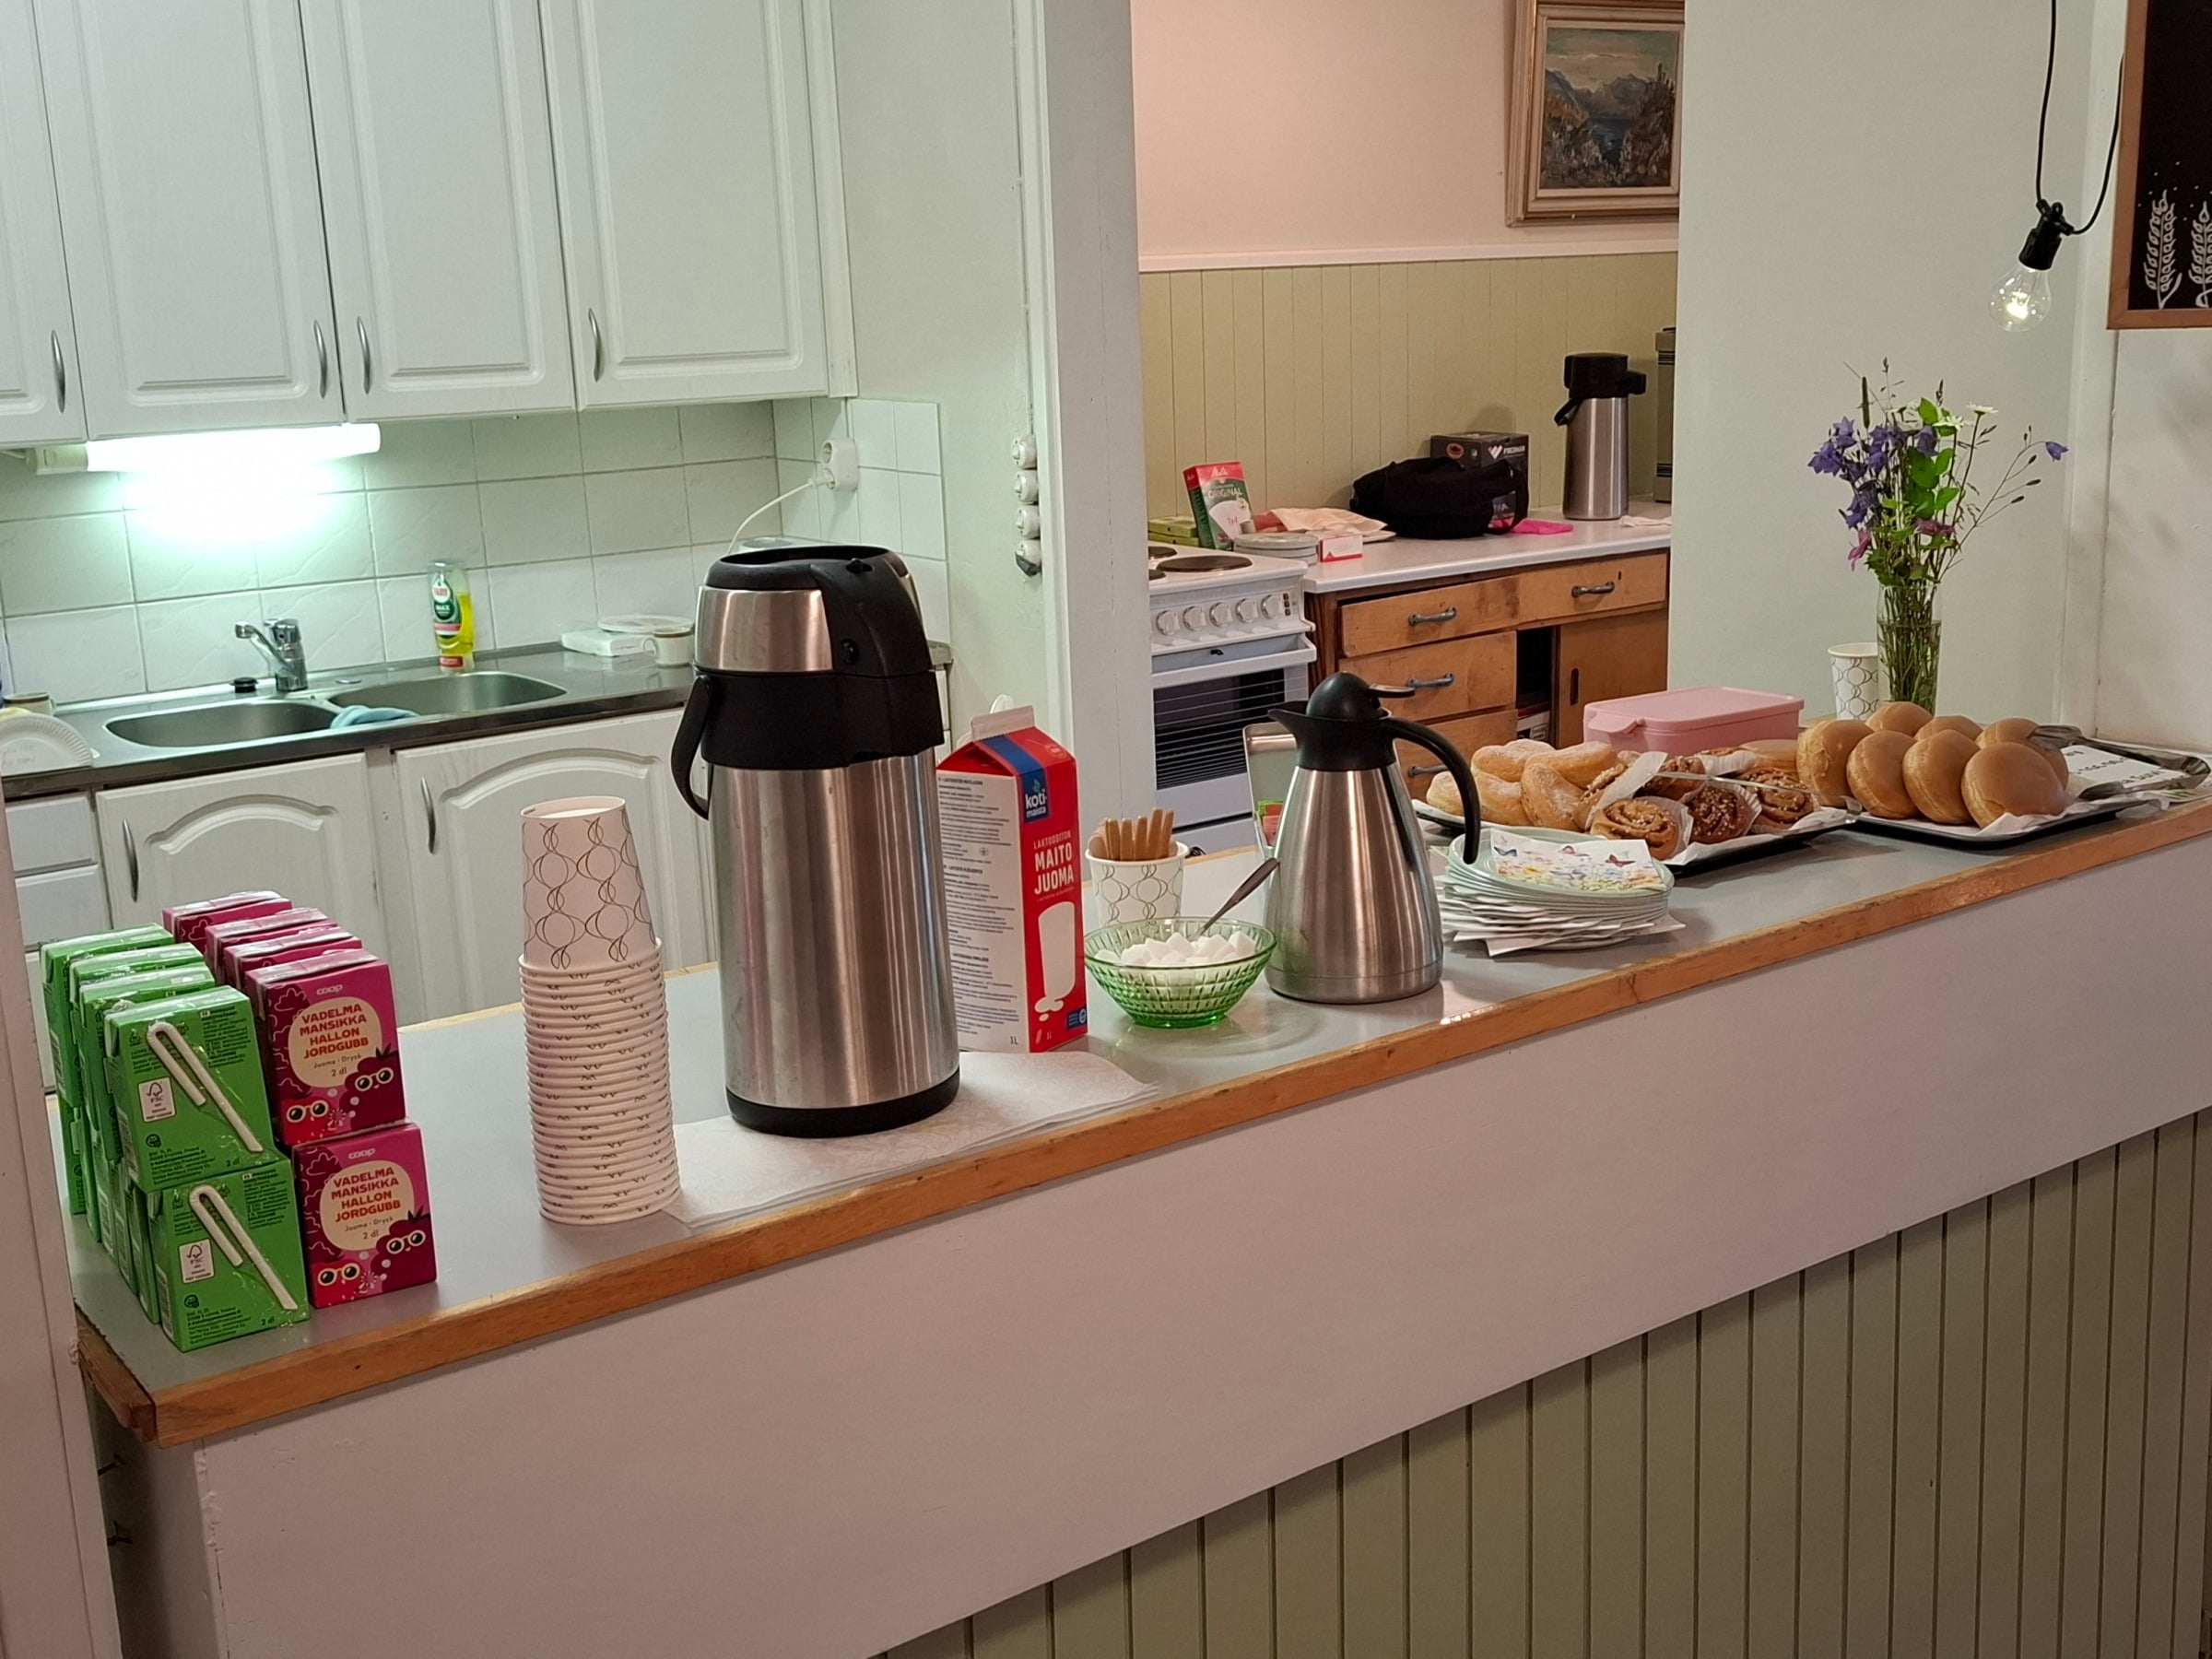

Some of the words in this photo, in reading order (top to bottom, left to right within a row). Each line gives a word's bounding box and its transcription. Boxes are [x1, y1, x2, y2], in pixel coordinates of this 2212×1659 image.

[1208, 487, 1243, 499] ORIGINAL
[1034, 842, 1073, 872] MAITO
[1034, 865, 1075, 895] JUOMA
[316, 983, 343, 995] coop
[301, 1003, 362, 1025] VADELMA
[300, 1014, 367, 1037] MANSIKKA
[309, 1027, 359, 1046] HALLON
[303, 1037, 369, 1059] JORDGUBB
[339, 1066, 347, 1075] dl
[348, 1147, 376, 1159] coop
[334, 1167, 394, 1188] VADELMA
[331, 1177, 399, 1200] MANSIKKA
[341, 1191, 392, 1209] HALLON
[335, 1200, 401, 1222] JORDGUBB
[362, 1231, 368, 1240] 2
